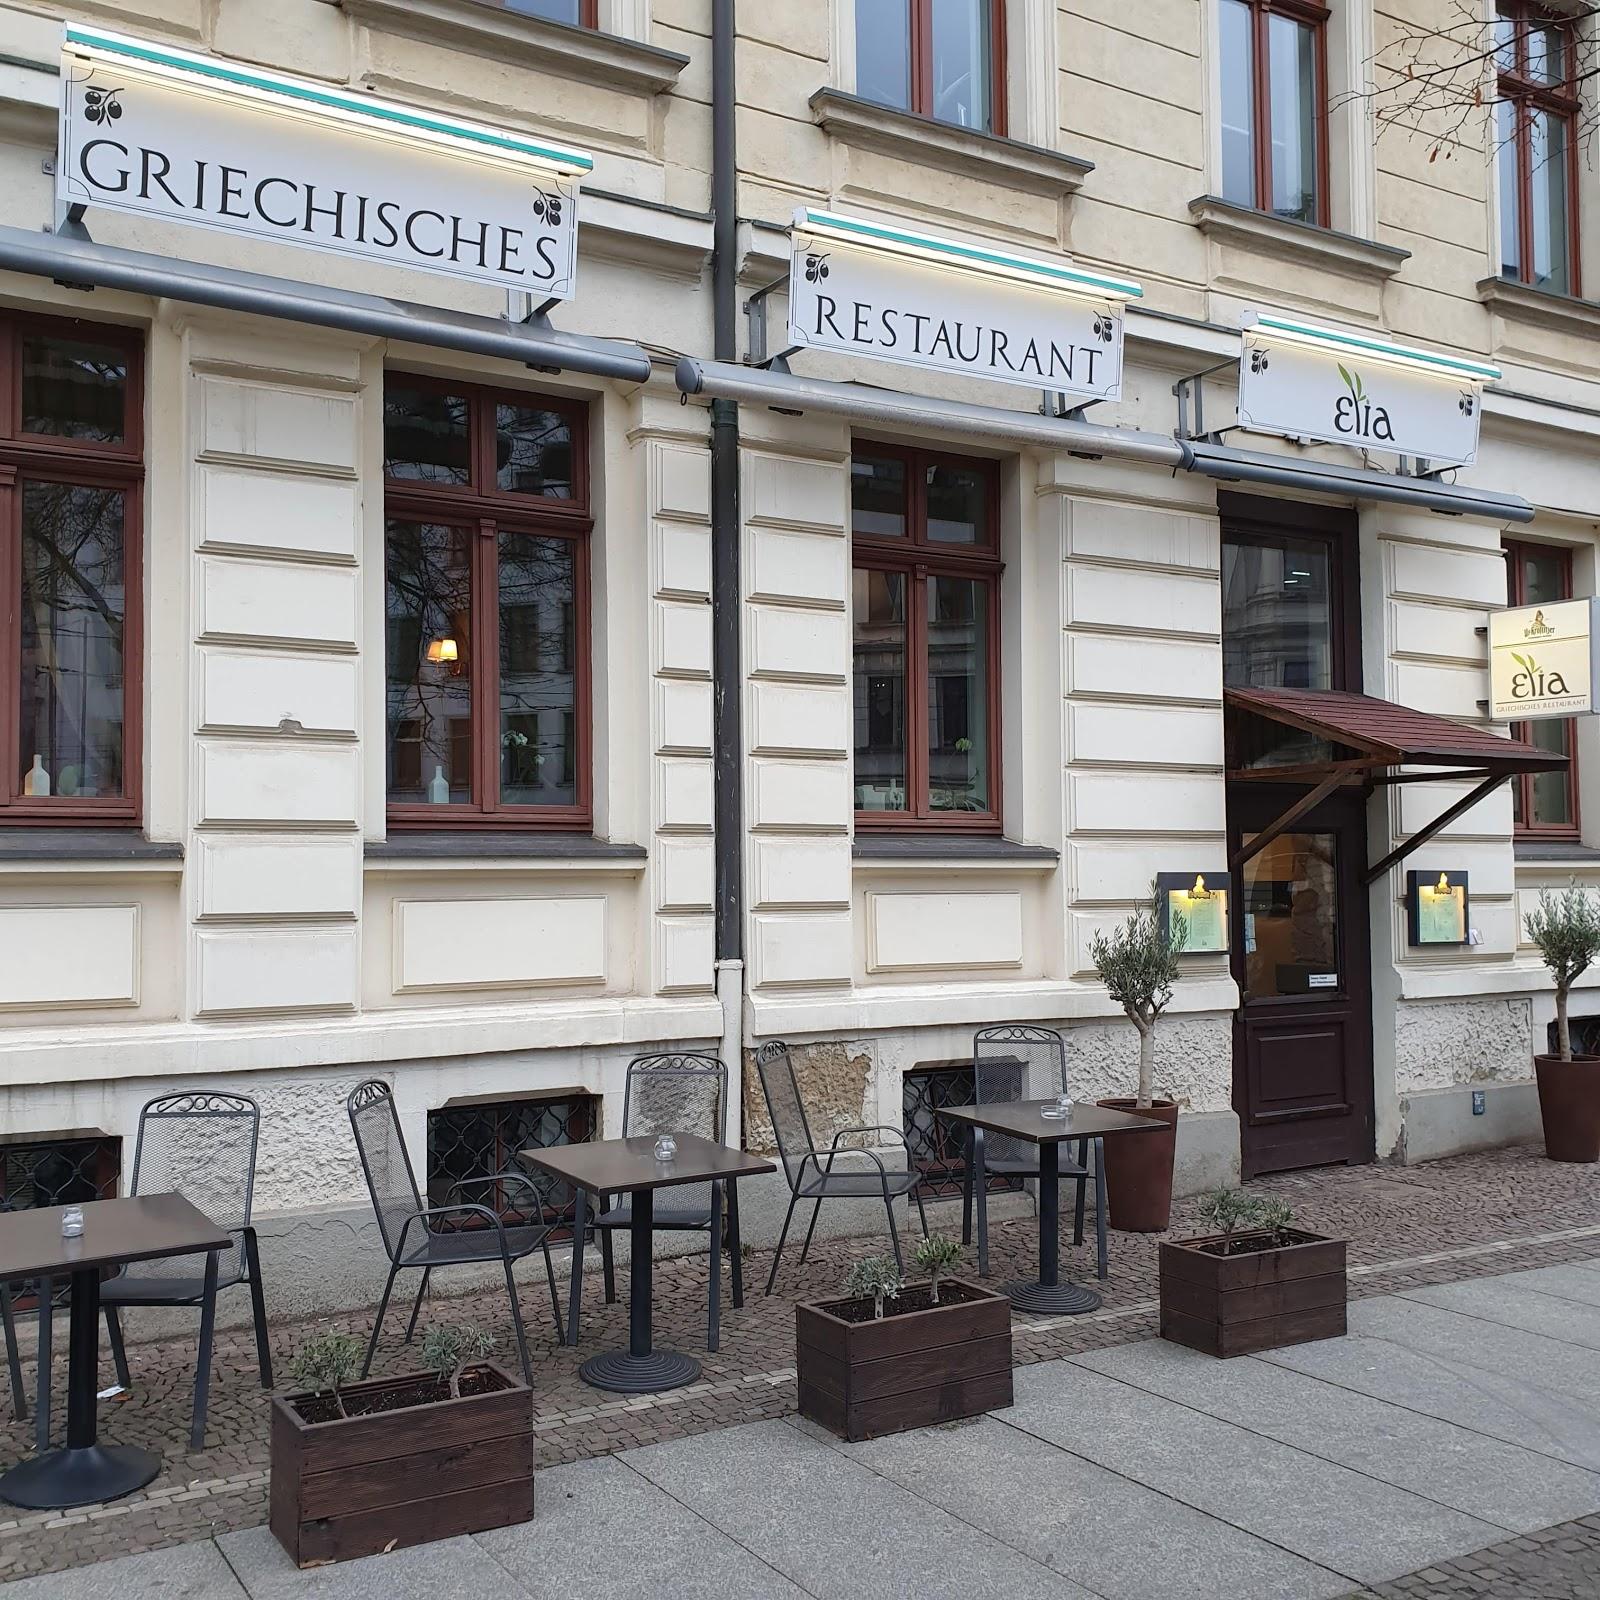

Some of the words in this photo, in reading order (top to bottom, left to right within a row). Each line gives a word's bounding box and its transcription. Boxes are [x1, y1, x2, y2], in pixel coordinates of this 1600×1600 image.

[79, 138, 558, 281] GRIECHISCHES
[813, 294, 1103, 385] RESTAURANT
[1496, 702, 1541, 713] GRIECHISCHES
[1543, 699, 1586, 709] RESTAURANT
